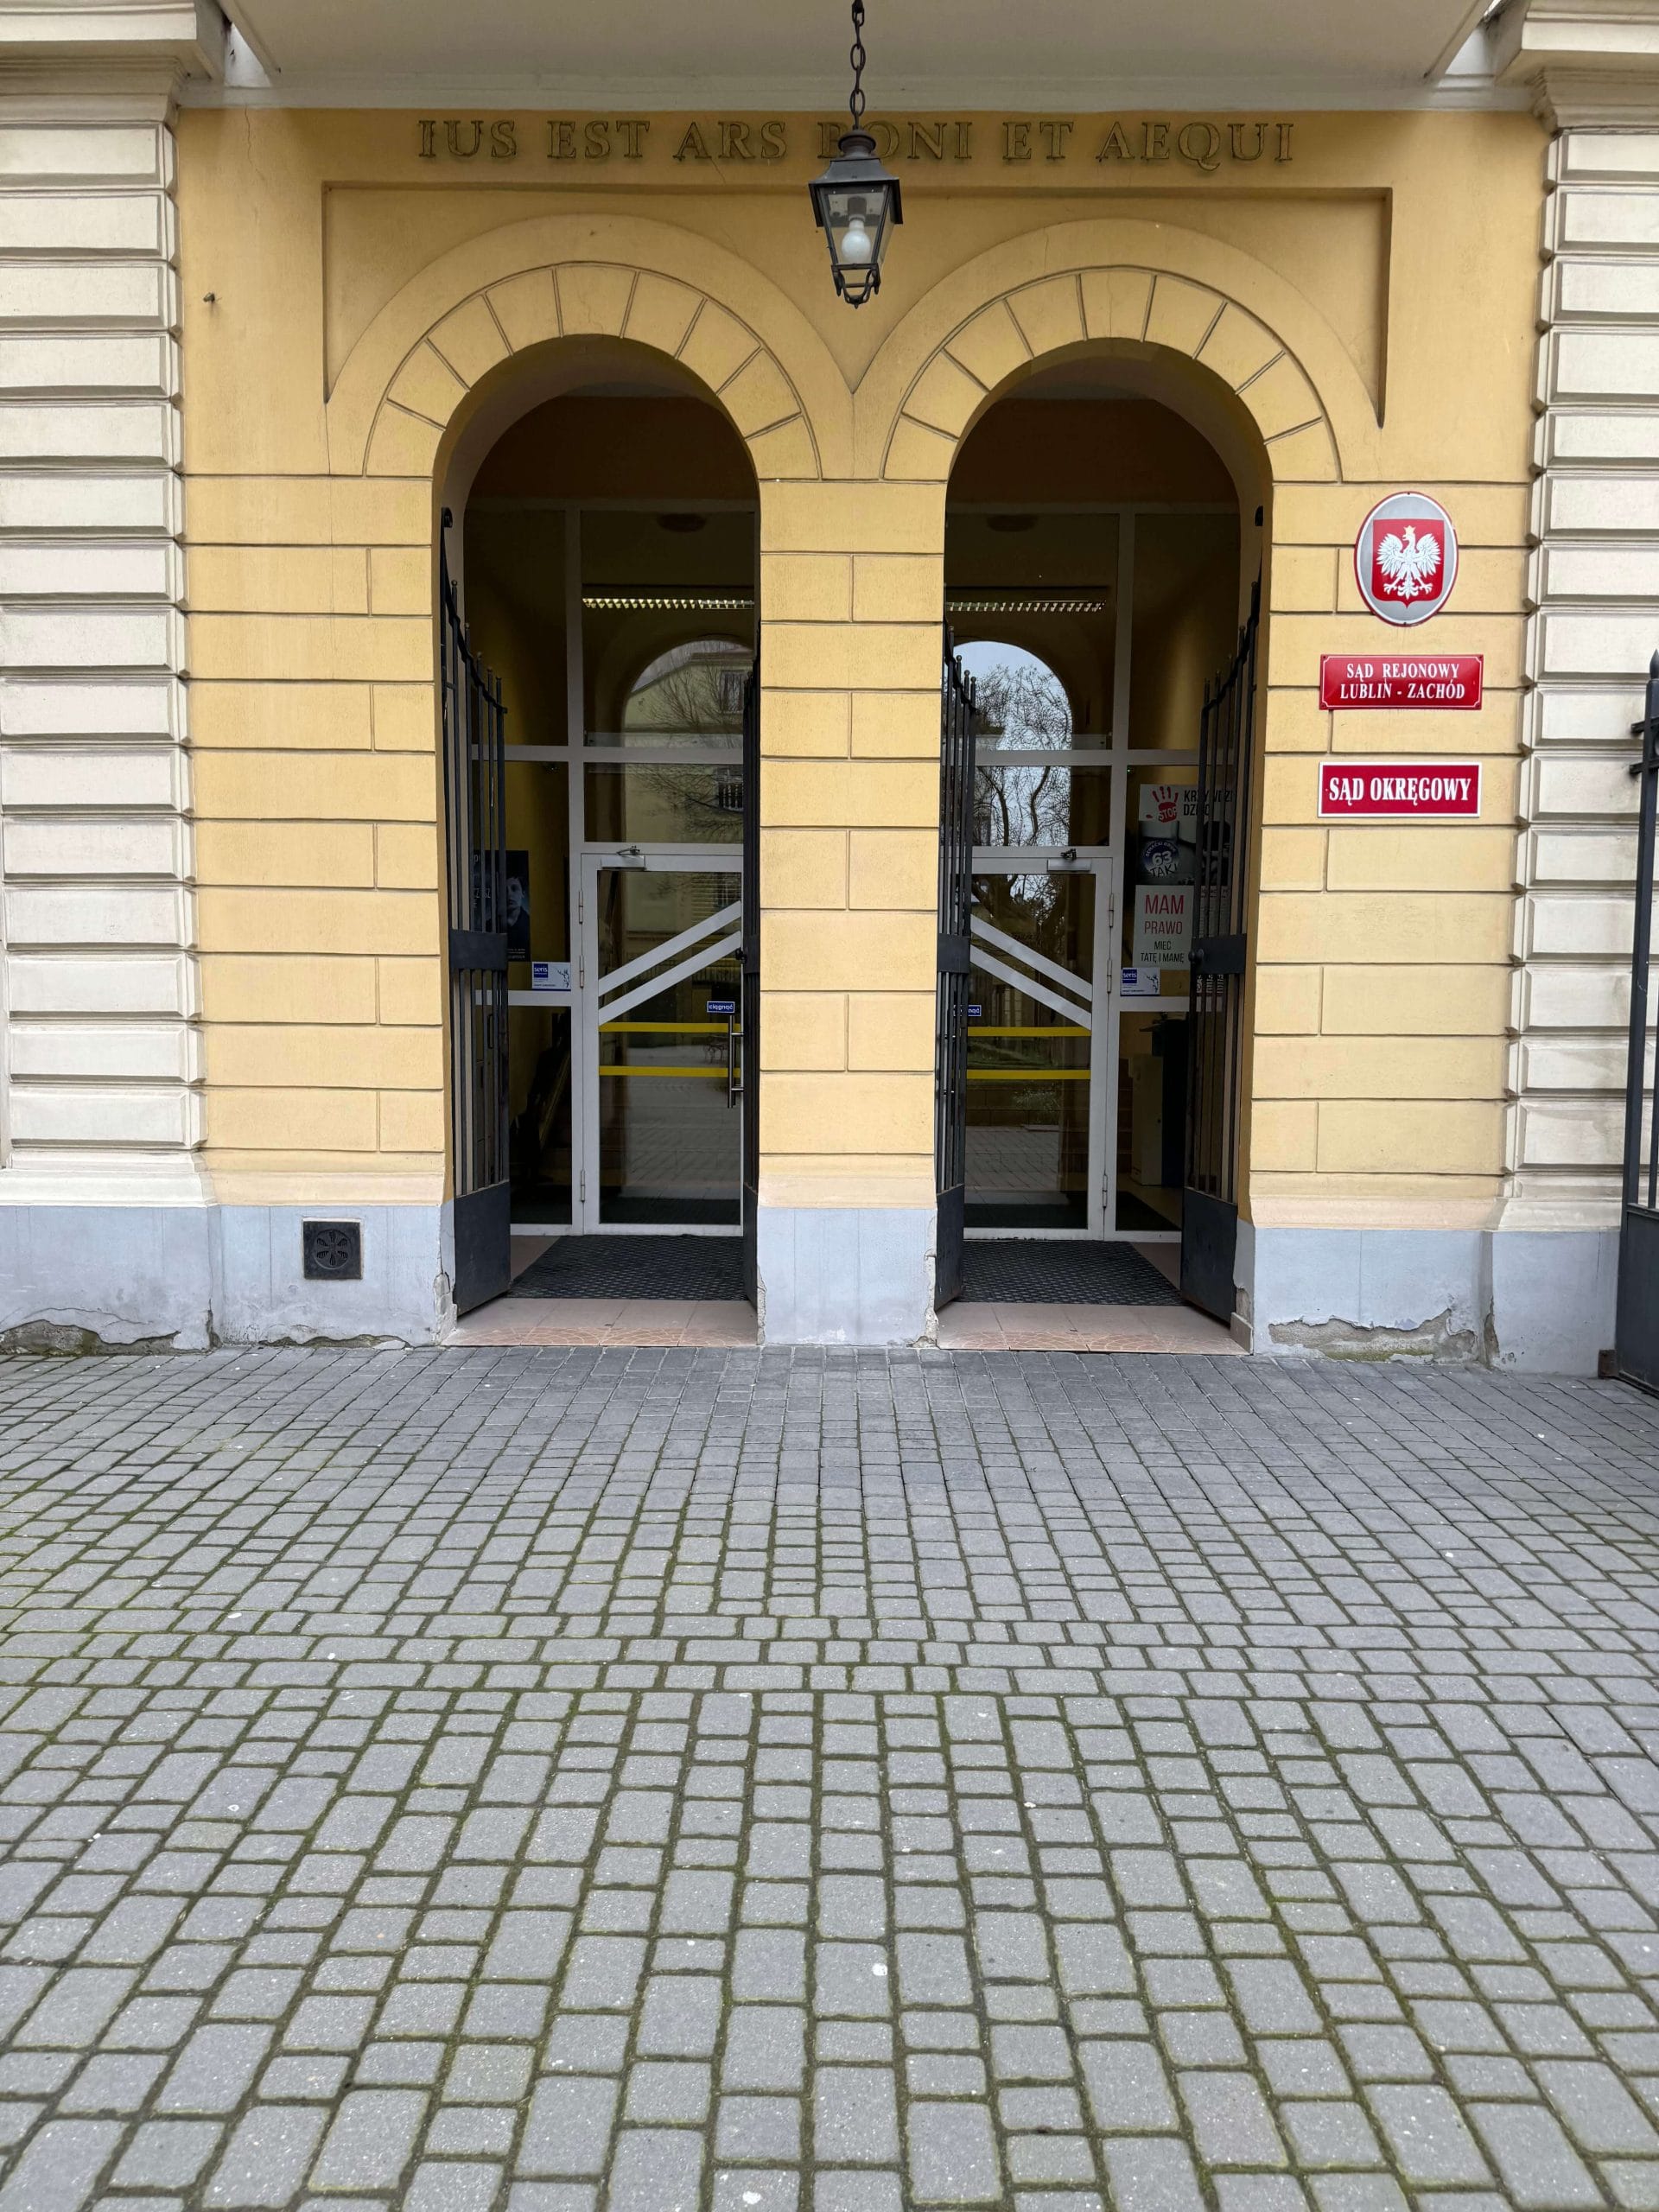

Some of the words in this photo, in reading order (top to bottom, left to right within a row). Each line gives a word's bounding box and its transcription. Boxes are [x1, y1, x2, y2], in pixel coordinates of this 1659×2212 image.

[418, 120, 517, 159] IUS
[547, 120, 650, 160] EST
[673, 120, 786, 161] ARS
[817, 121, 972, 159] BONI
[1002, 121, 1073, 160] ET
[1096, 121, 1294, 170] AEQUI
[1346, 663, 1374, 682] SĄD
[1382, 664, 1459, 679] REJONOWY
[1340, 682, 1393, 699] LUBLIN
[1408, 679, 1465, 699] ZACHÓD
[1329, 777, 1363, 805] SĄD
[1370, 777, 1471, 805] OKRĘGOWY
[1159, 806, 1176, 820] STOP
[1152, 851, 1173, 866] 63
[1145, 894, 1184, 914] MAM
[1144, 921, 1183, 935] PRAWO
